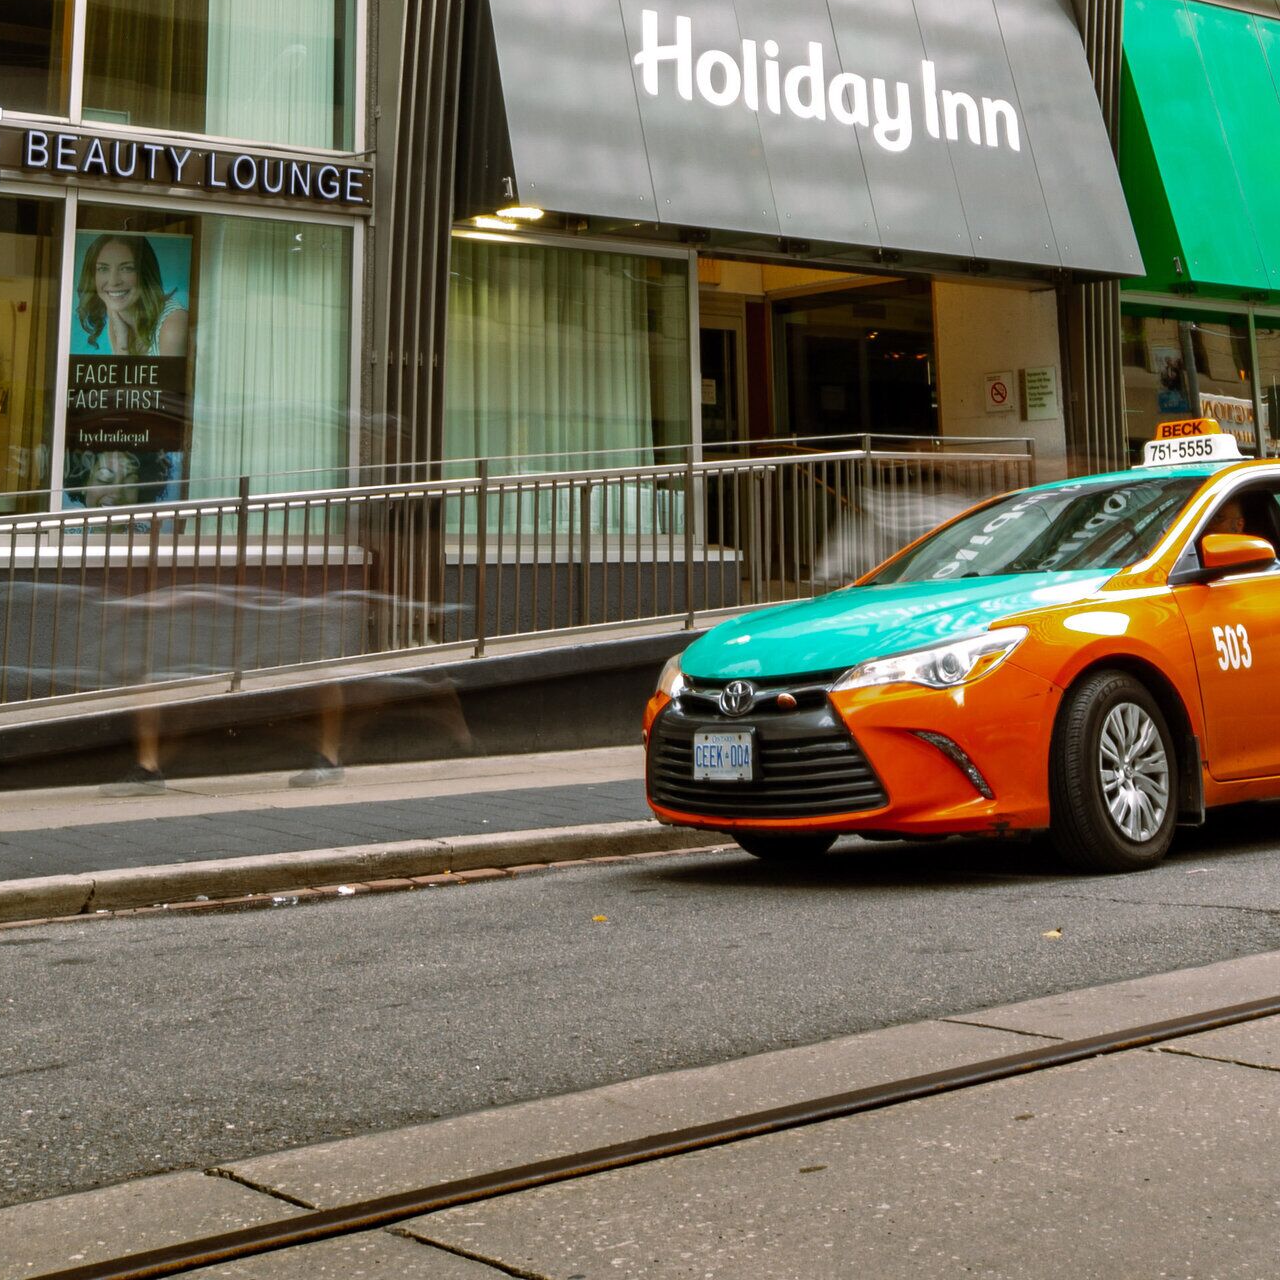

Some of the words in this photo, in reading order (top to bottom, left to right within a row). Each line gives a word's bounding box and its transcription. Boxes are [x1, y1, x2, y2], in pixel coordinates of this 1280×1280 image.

[634, 9, 912, 152] Holiday
[922, 59, 1021, 152] Inn
[23, 129, 191, 182] BEAUTY
[207, 151, 365, 202] LOUNGE
[75, 364, 118, 384] FACE
[124, 365, 159, 385] LIFE
[66, 388, 108, 409] FACE
[116, 389, 166, 409] FIRST.
[79, 429, 149, 447] hydrafacial
[1162, 421, 1202, 438] BECK
[1150, 438, 1213, 462] 751-5555
[1212, 623, 1252, 671] 503
[695, 745, 724, 768] CEEK
